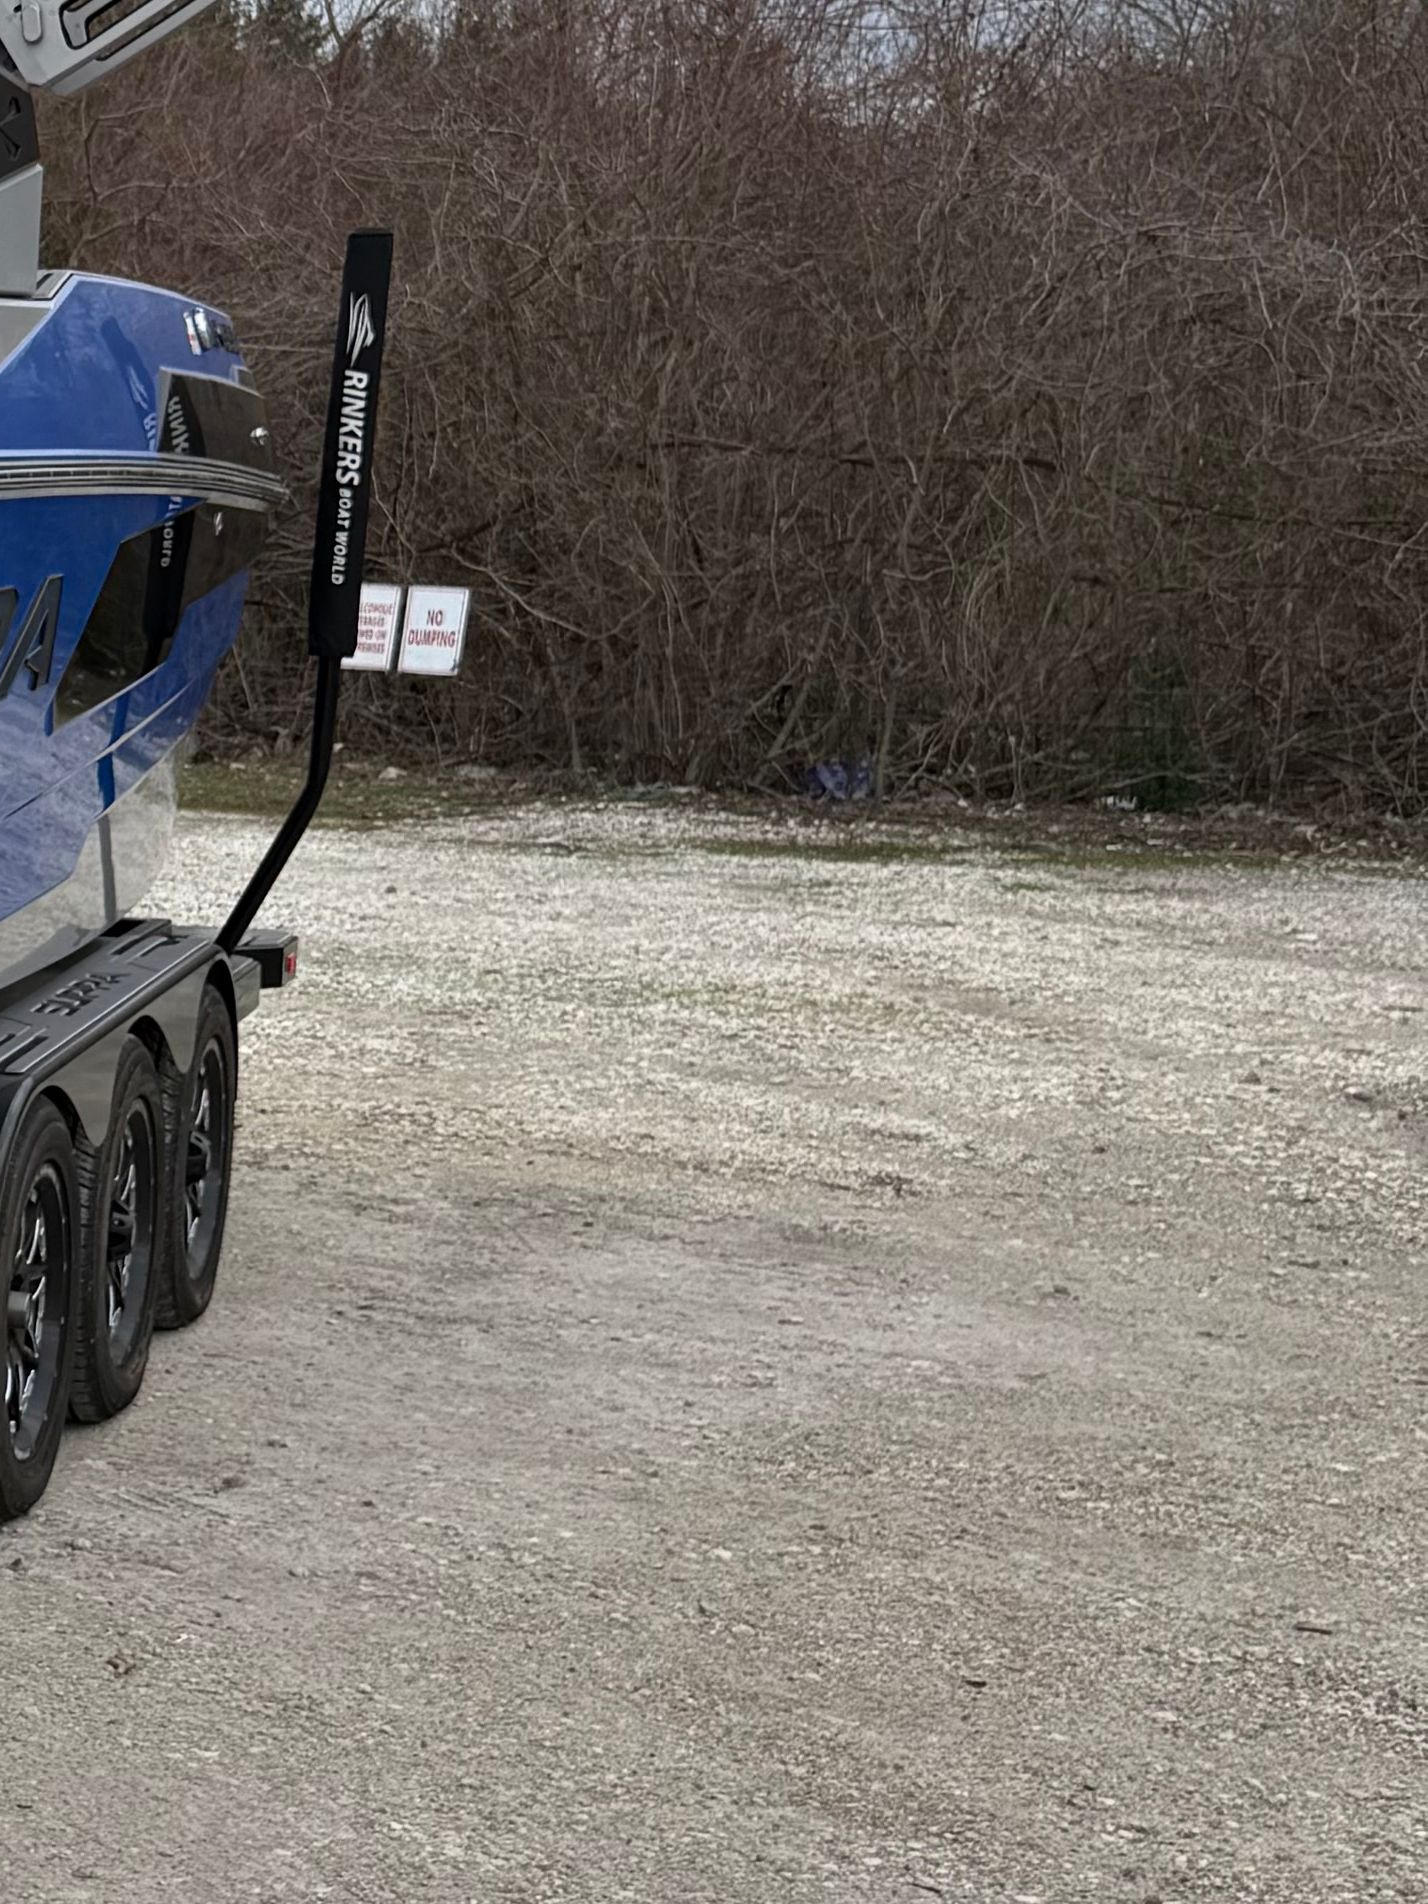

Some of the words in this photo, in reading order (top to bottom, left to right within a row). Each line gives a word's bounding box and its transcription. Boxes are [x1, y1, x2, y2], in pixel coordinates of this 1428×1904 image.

[335, 369, 369, 486] RINKERS
[336, 488, 353, 529] BOAT
[331, 531, 350, 585] WORLD
[407, 628, 457, 648] DUMPING
[426, 609, 444, 626] NO
